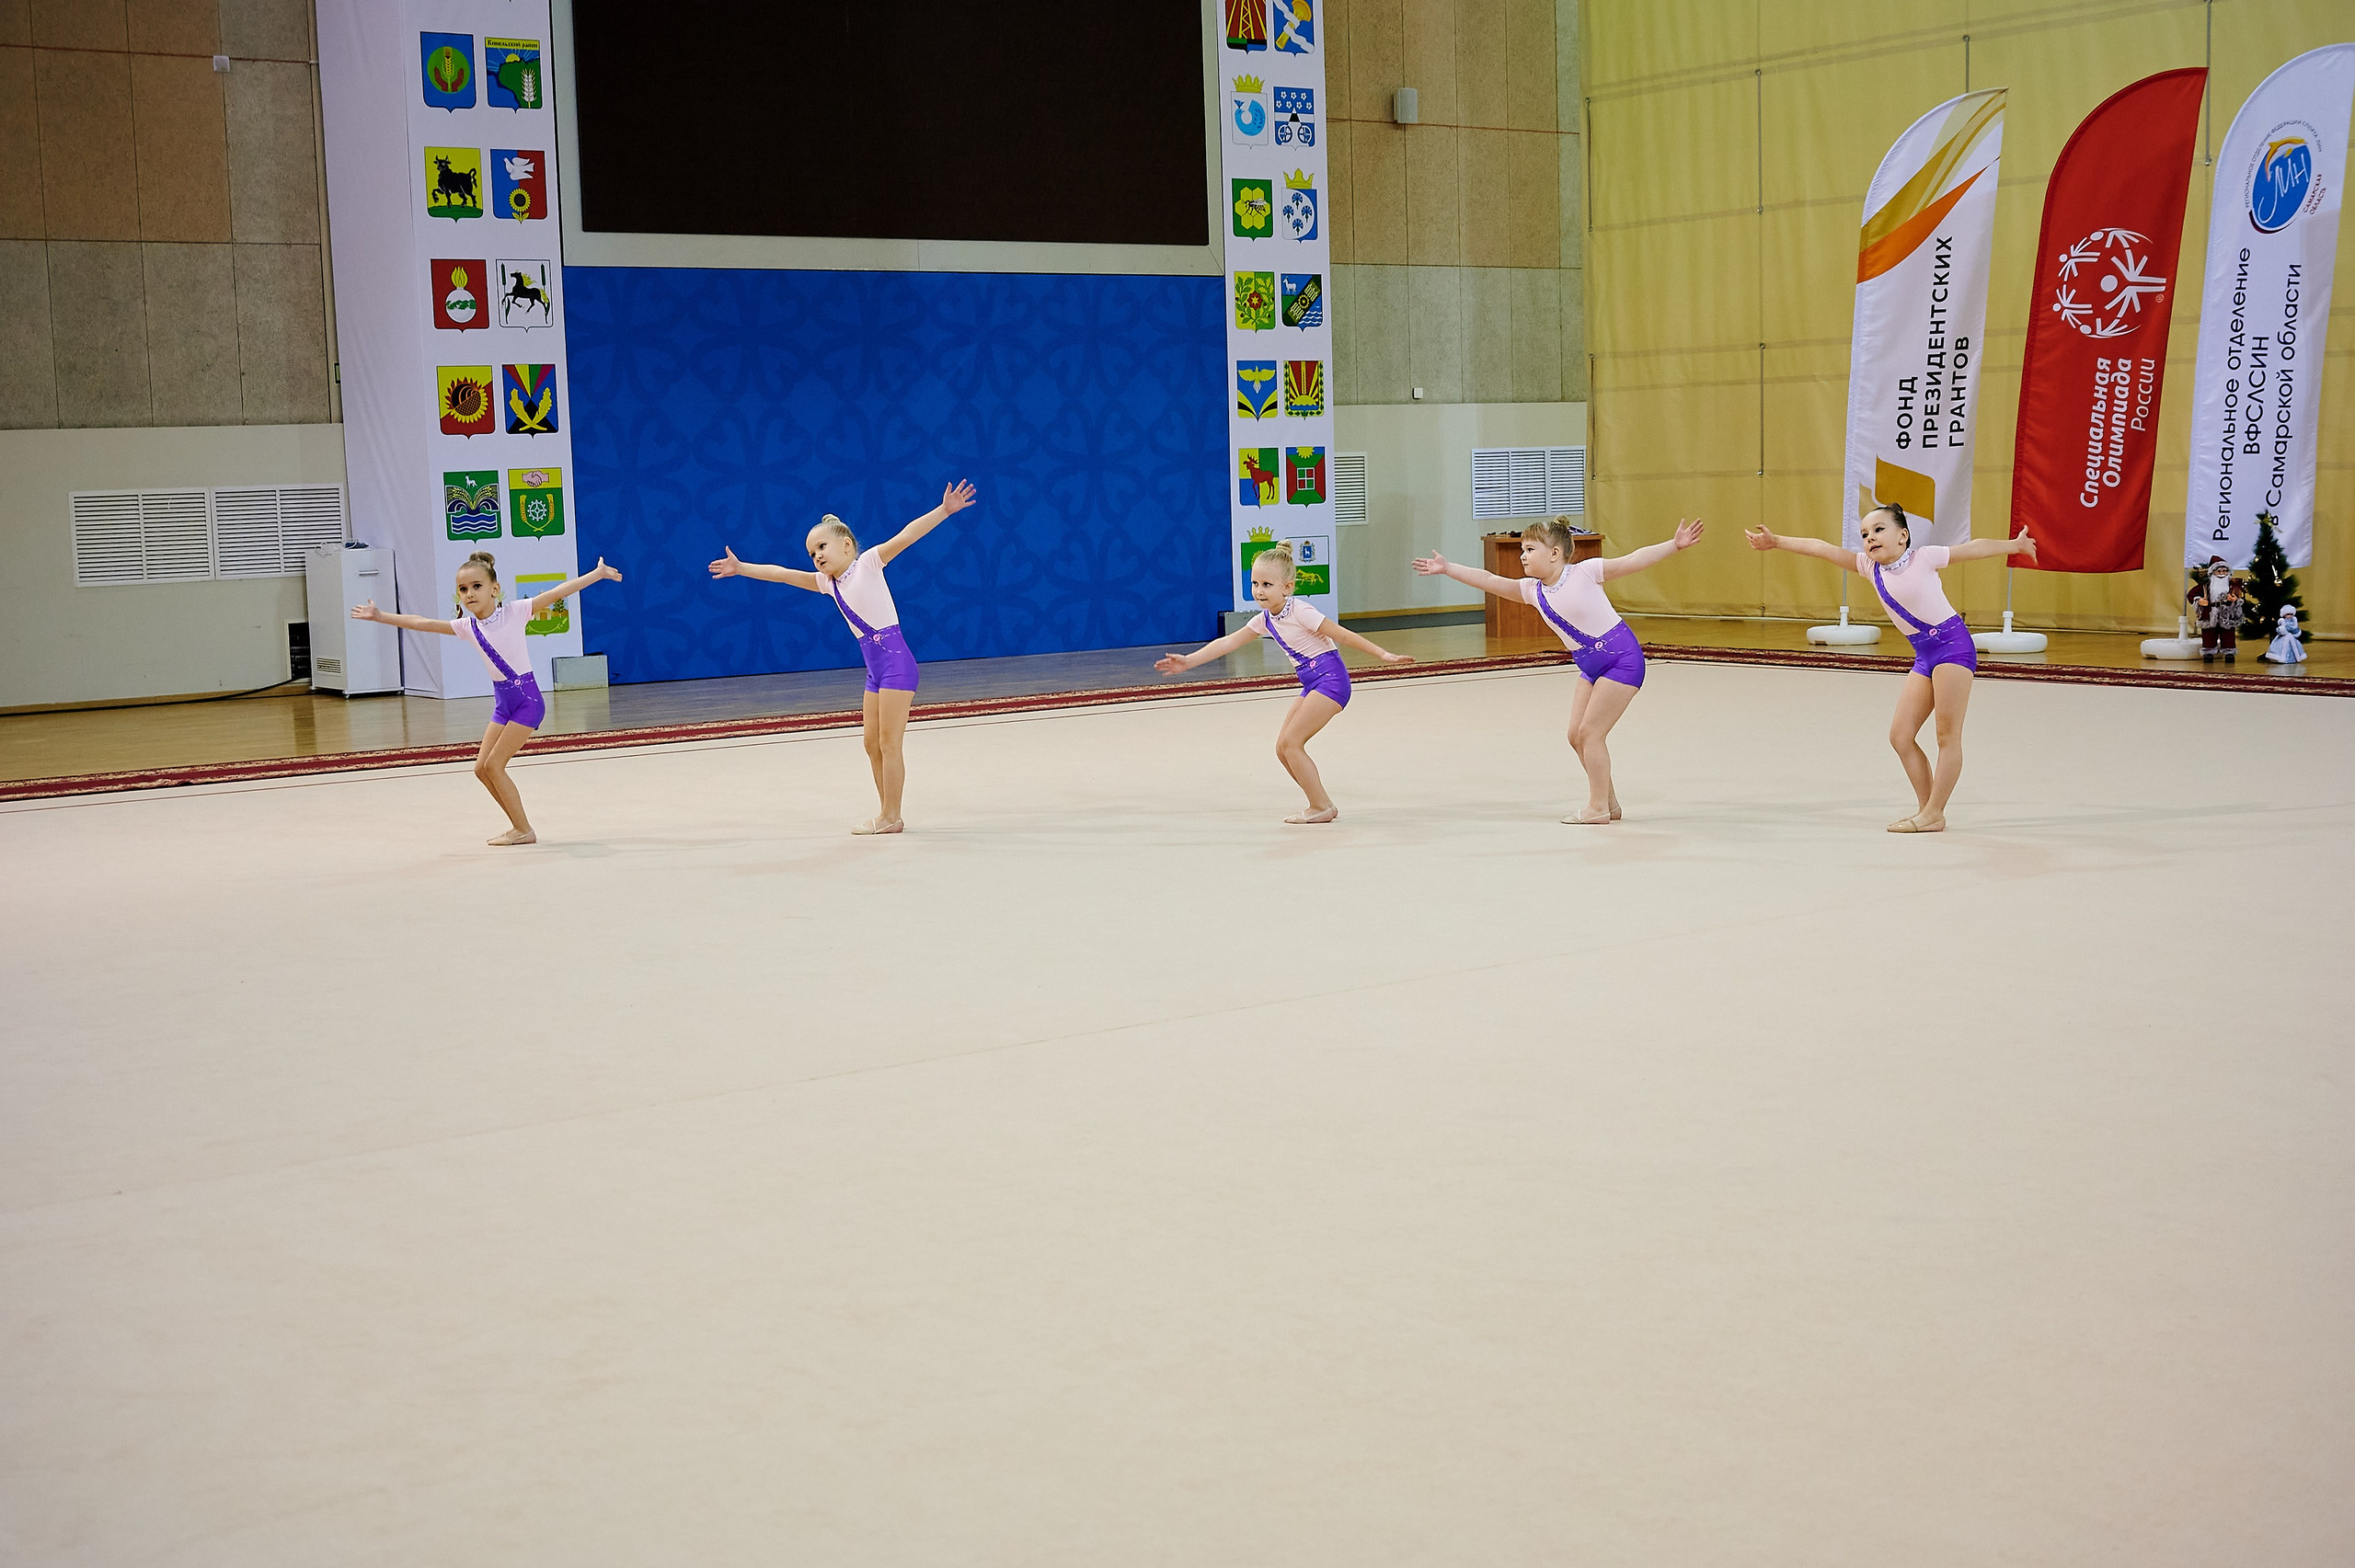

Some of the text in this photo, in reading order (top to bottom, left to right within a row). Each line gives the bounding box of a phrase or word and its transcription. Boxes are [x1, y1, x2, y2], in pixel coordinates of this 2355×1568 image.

[2245, 165, 2255, 208] РЕГИОНАЛЬНОЕ
[2303, 174, 2323, 212] САМАРСКАЯ
[2309, 188, 2326, 214] ОБЛАСТЬ
[1923, 235, 1953, 449] ПРЕЗИДЕНТСКИХ
[2277, 264, 2303, 361] области
[1896, 376, 1918, 450] ФОНД
[1948, 336, 1970, 448] ГРАНТОВ
[2079, 357, 2111, 508] Специальная
[2102, 358, 2131, 488] Олимпиада
[2131, 358, 2155, 431] России
[2212, 247, 2250, 541] Региональное отделение
[2243, 337, 2269, 454] ВФСЛСИН
[2266, 369, 2294, 508] Самарской
